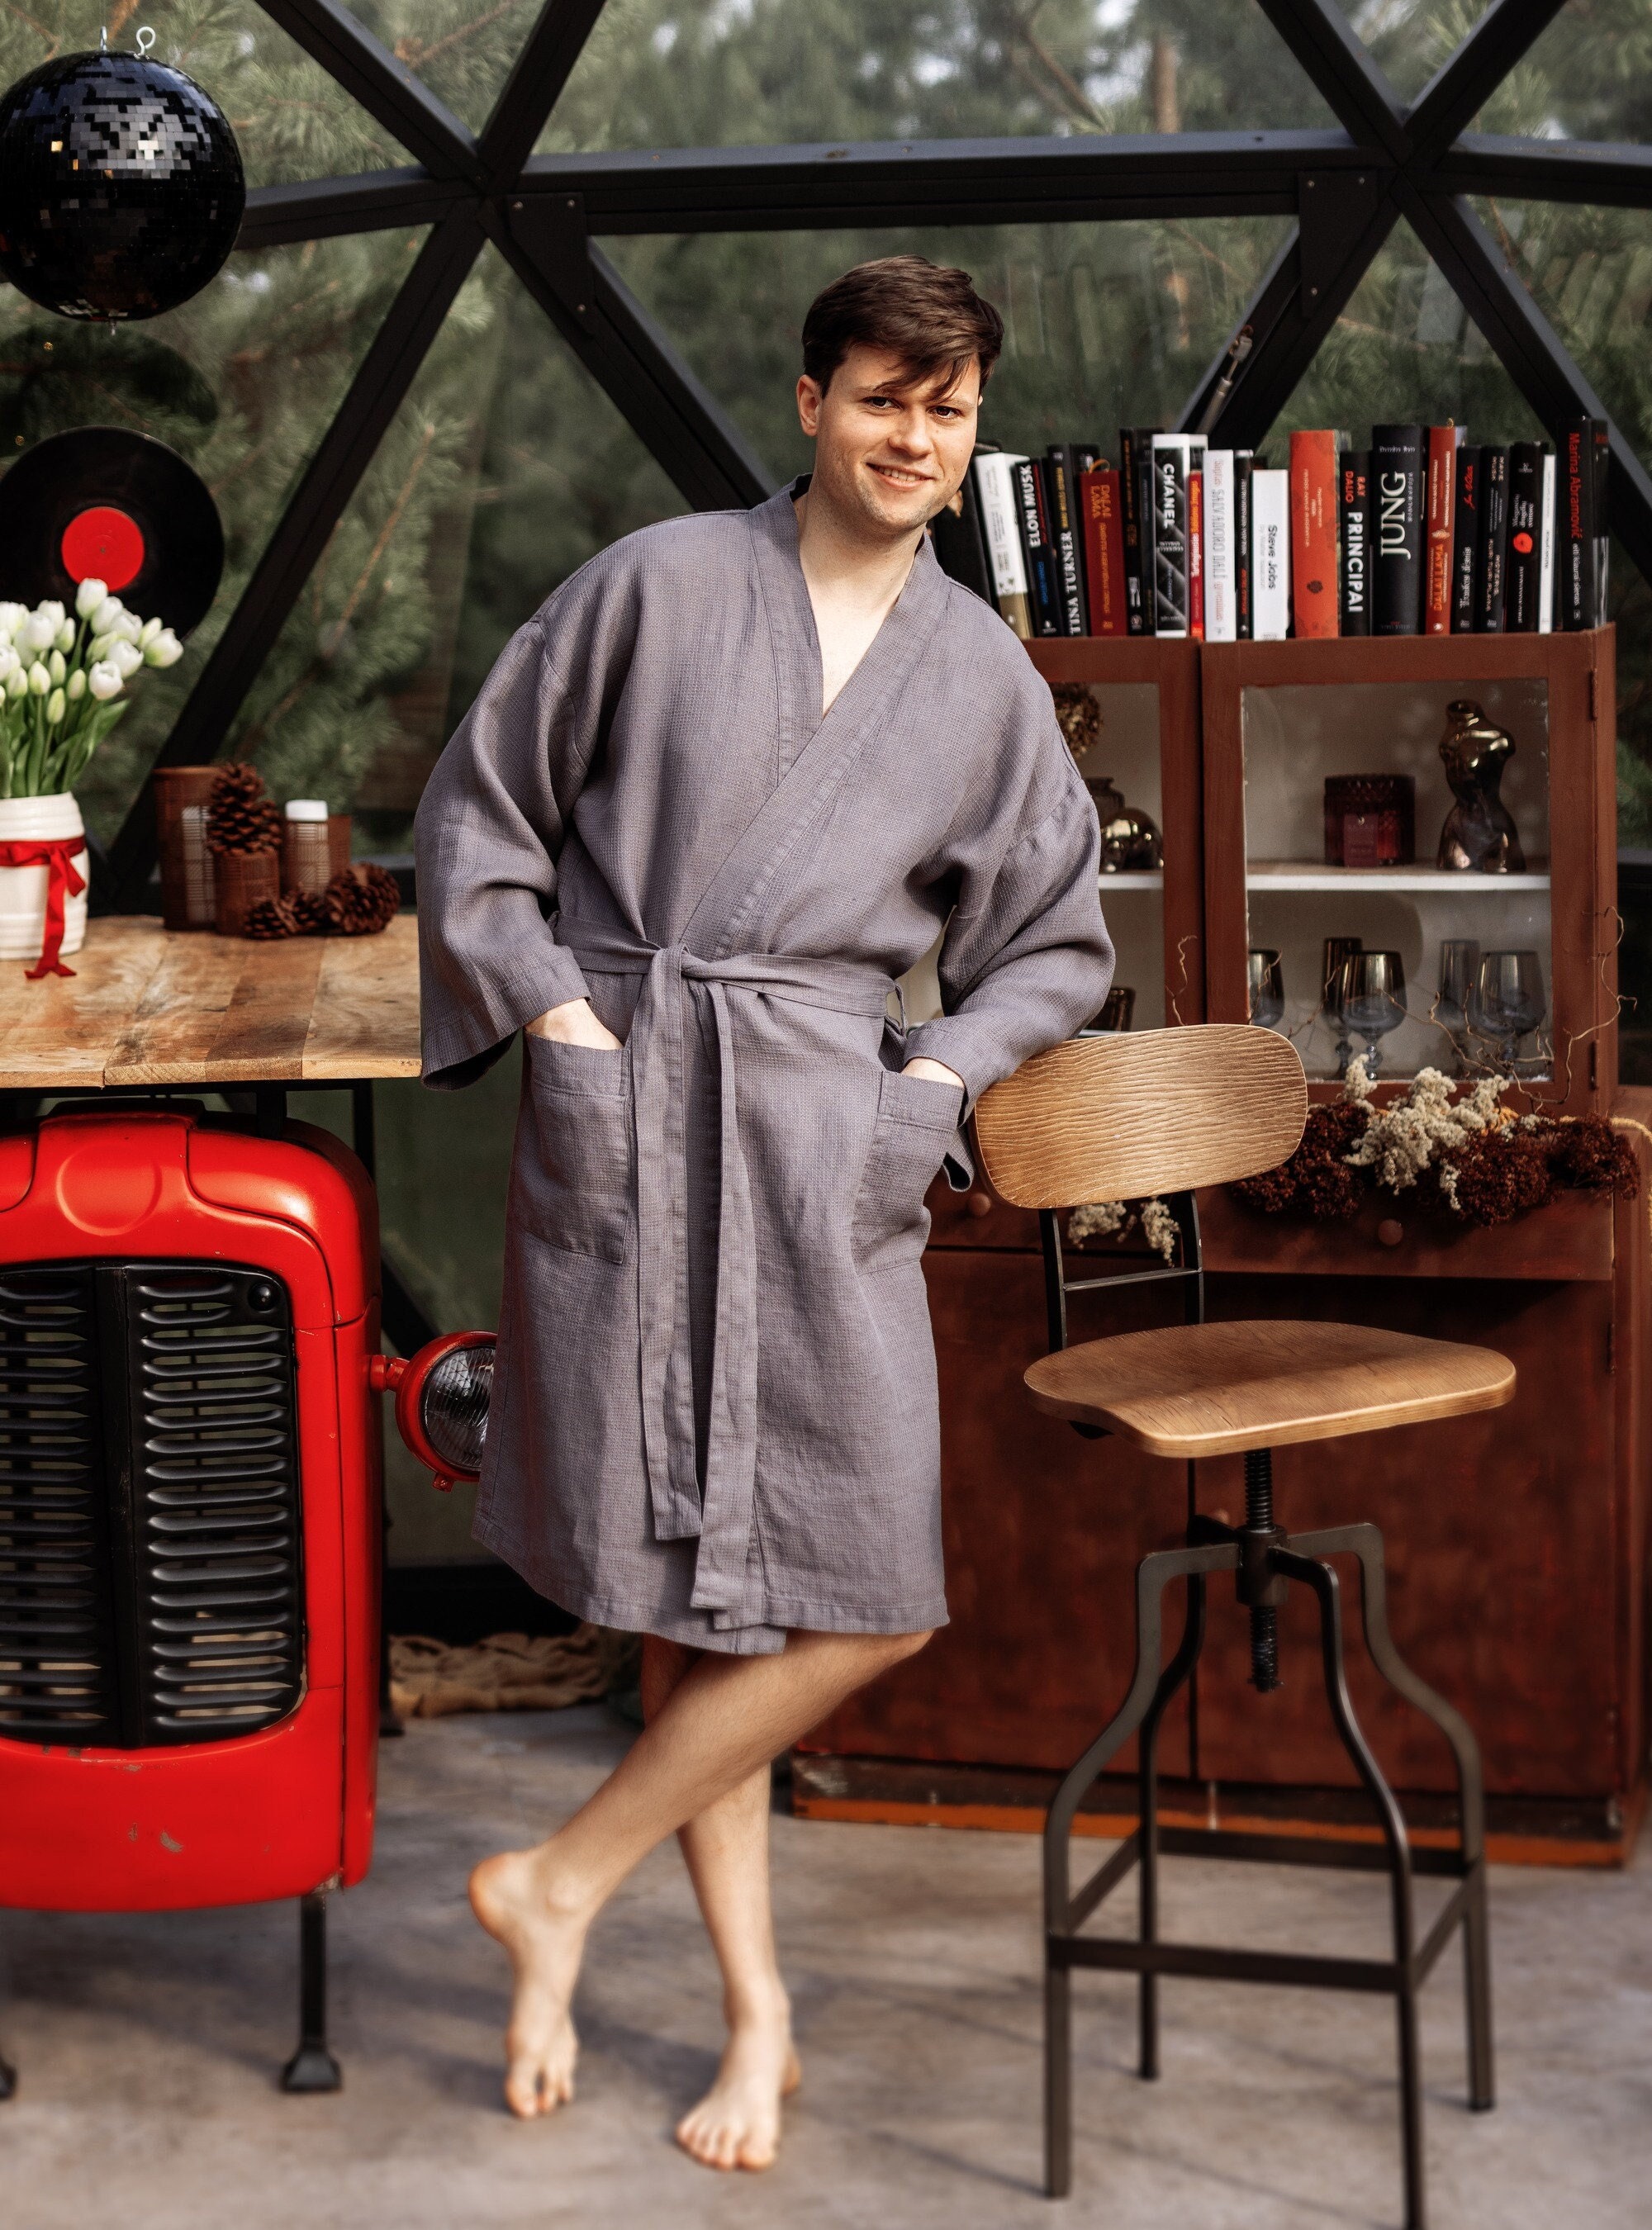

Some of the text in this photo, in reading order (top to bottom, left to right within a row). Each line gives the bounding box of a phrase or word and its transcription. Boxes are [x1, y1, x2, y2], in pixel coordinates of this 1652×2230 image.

[1020, 464, 1036, 507] MUSK
[1090, 486, 1102, 519] LAMA
[1101, 484, 1112, 519] DALAI
[1162, 463, 1175, 529] CHANEL
[1345, 471, 1355, 504] DALIO
[1356, 477, 1365, 497] RAY
[1380, 471, 1412, 561] JUNG
[1569, 433, 1583, 539] Marina Abramović
[1025, 508, 1041, 548] ELON
[1212, 489, 1225, 552] SALVADORO
[1061, 530, 1081, 635] TINA TURNER
[1268, 524, 1278, 589] Steve Jobs
[1347, 511, 1364, 613] PRINCIPAI
[1433, 543, 1444, 611] DALAI LAMA
